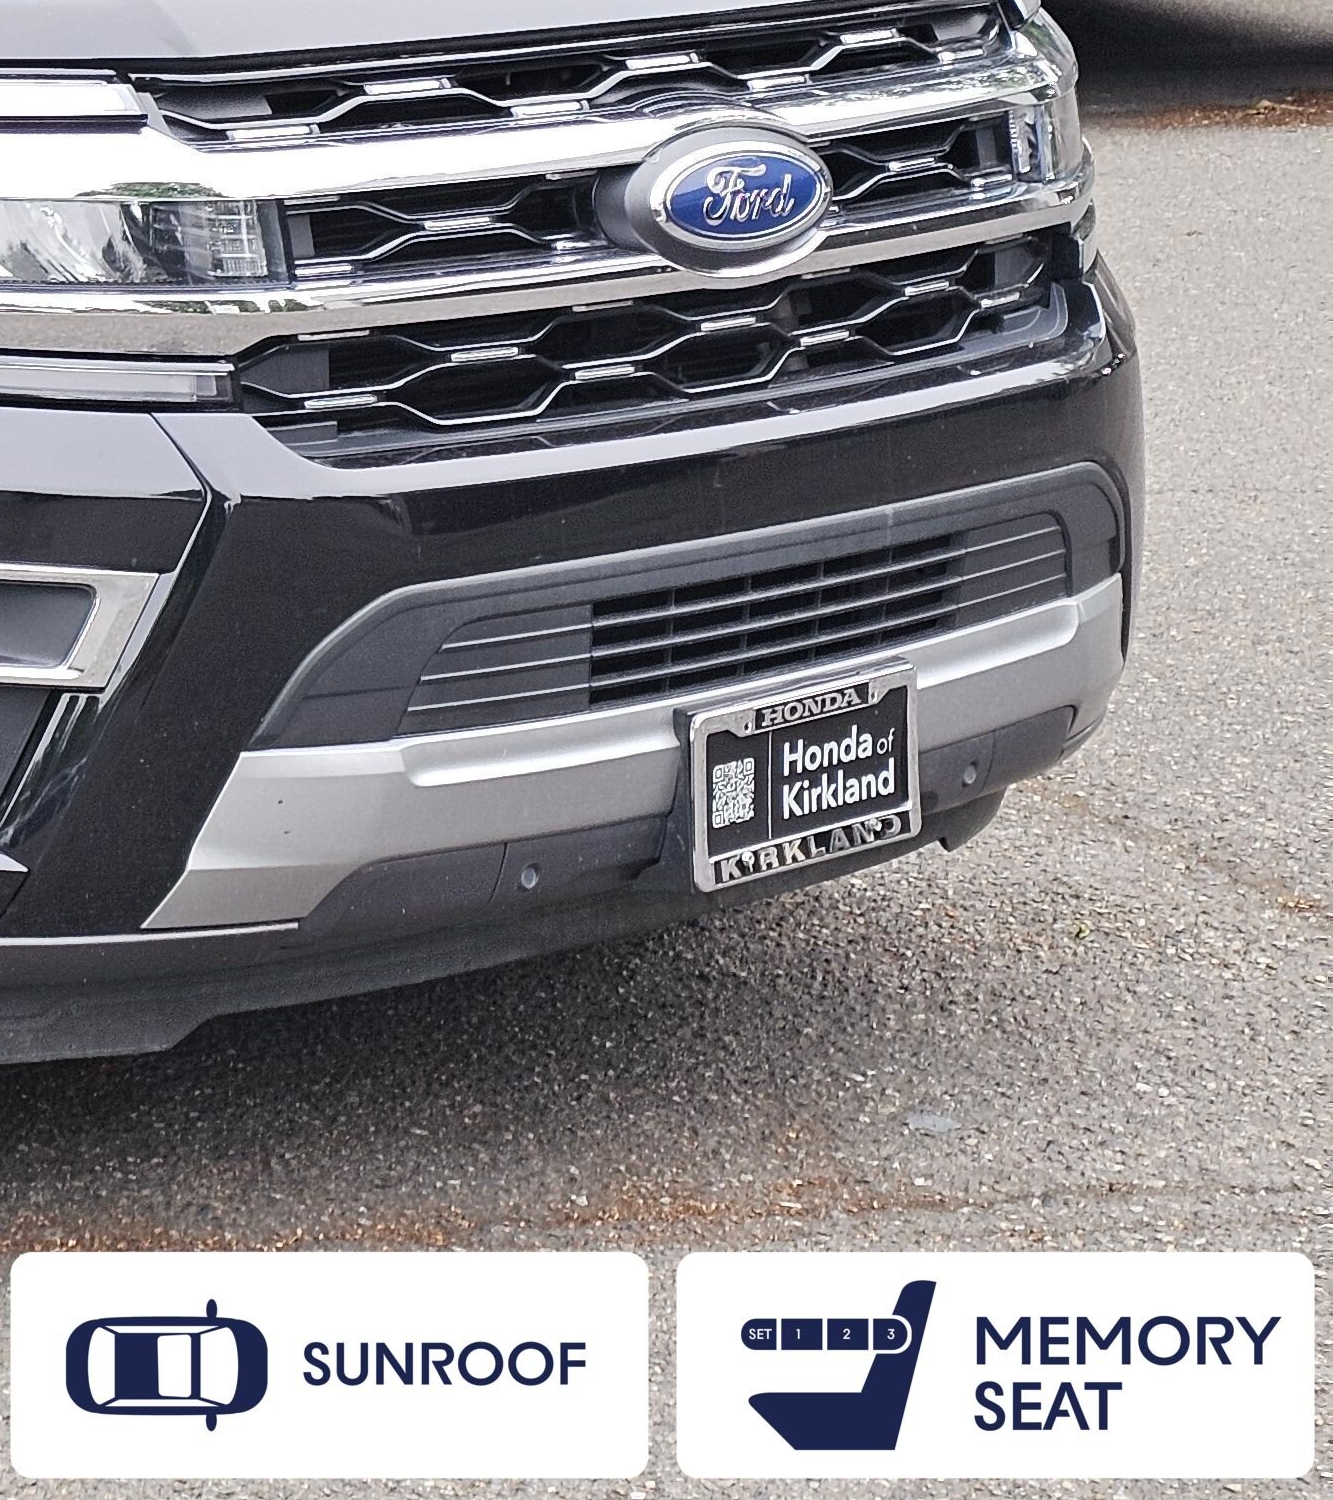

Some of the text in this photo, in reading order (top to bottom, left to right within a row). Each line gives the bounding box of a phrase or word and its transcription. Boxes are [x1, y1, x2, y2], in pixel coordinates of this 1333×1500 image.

[702, 163, 795, 226] Ford
[761, 688, 862, 728] HONDA
[783, 724, 896, 778] Honda of
[783, 757, 896, 820] Kirkland
